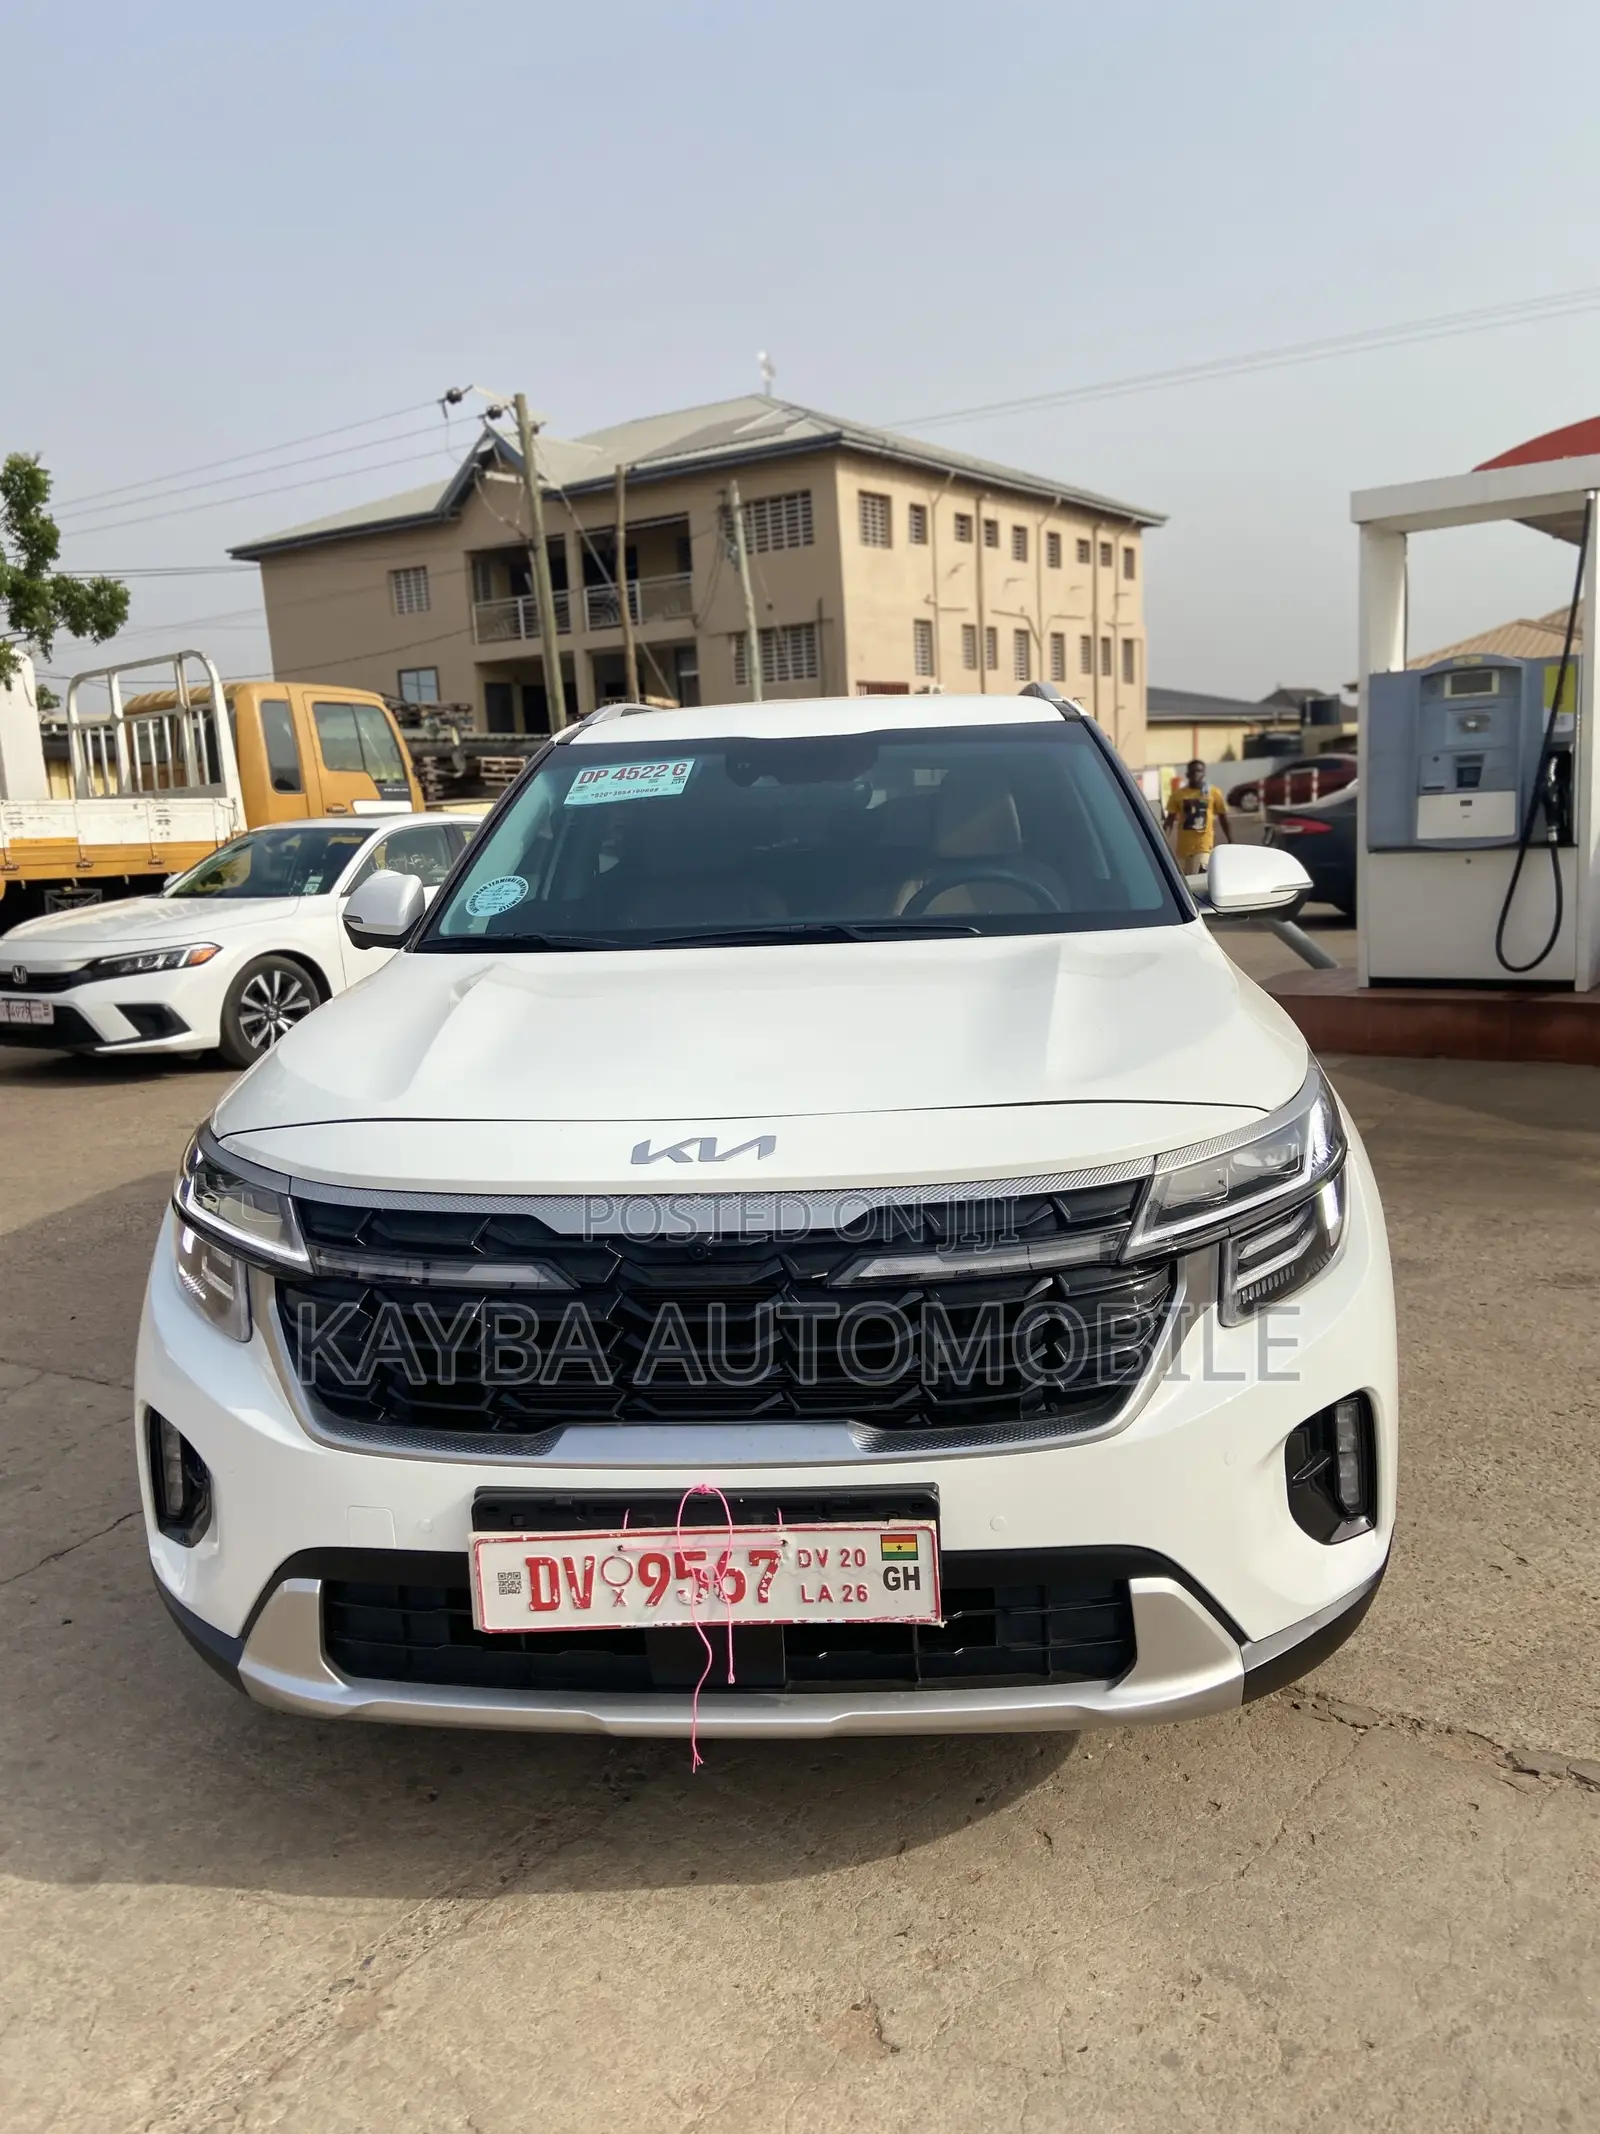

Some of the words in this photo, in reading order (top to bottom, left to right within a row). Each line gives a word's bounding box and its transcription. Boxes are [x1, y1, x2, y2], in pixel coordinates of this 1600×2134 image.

[578, 770, 609, 784] DP
[611, 765, 669, 780] 4522
[671, 763, 688, 776] G
[631, 1135, 776, 1164] KIA
[798, 1549, 829, 1568] DV
[839, 1548, 867, 1568] 20
[525, 1554, 596, 1612] DV
[637, 1549, 783, 1609] 9567
[882, 1565, 921, 1592] GH
[800, 1584, 835, 1604] LA
[841, 1583, 869, 1603] 26
